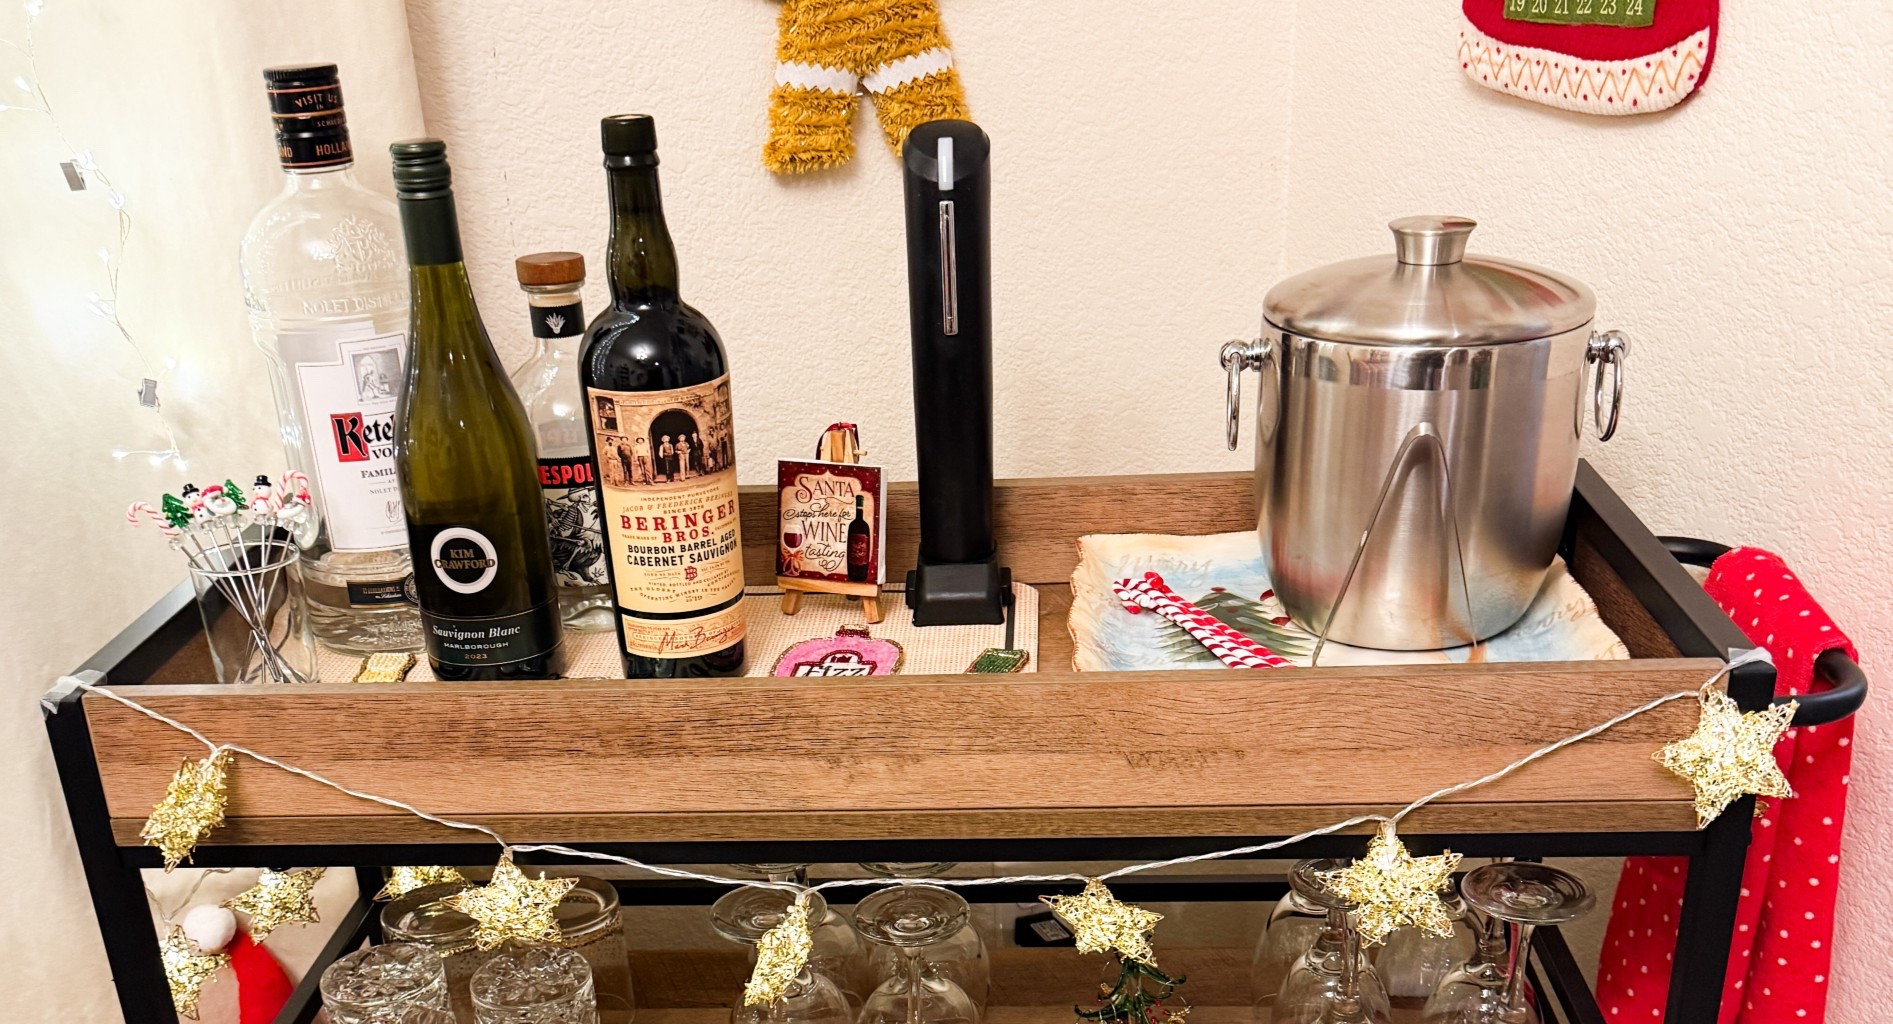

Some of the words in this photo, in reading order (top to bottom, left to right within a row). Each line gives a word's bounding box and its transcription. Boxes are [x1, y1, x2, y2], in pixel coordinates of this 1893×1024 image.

[1509, 0, 1525, 11] 19
[1532, 0, 1547, 13] 20
[1554, 0, 1569, 14] 21
[1576, 0, 1591, 14] 22
[1600, 0, 1616, 14] 23
[1626, 0, 1643, 15] 24
[295, 94, 323, 108] VISIT
[372, 448, 393, 459] VO
[361, 468, 397, 478] FAMIL
[795, 476, 856, 503] SANTA
[641, 494, 685, 502] INDEPENDENT
[622, 505, 644, 514] JACOB
[657, 498, 703, 509] FREDERICK
[663, 507, 687, 515] SINCE
[811, 503, 837, 519] here
[837, 508, 853, 523] for
[620, 500, 735, 531] BERINGER
[662, 526, 714, 543] BROS.
[802, 520, 847, 544] WINE
[628, 545, 675, 555] BOURBON
[681, 539, 717, 553] BARREL
[720, 529, 735, 543] AGED
[450, 548, 475, 559] KIM
[627, 555, 684, 567] CABERNET
[690, 539, 737, 563] SAUVIGNON
[804, 543, 846, 572] tasting
[434, 558, 496, 569] CRAWFORD
[640, 592, 673, 601] OPERATING
[432, 624, 485, 641] Sauvignon
[489, 626, 521, 638] Blanc
[443, 642, 509, 650] MARLBOROUGH
